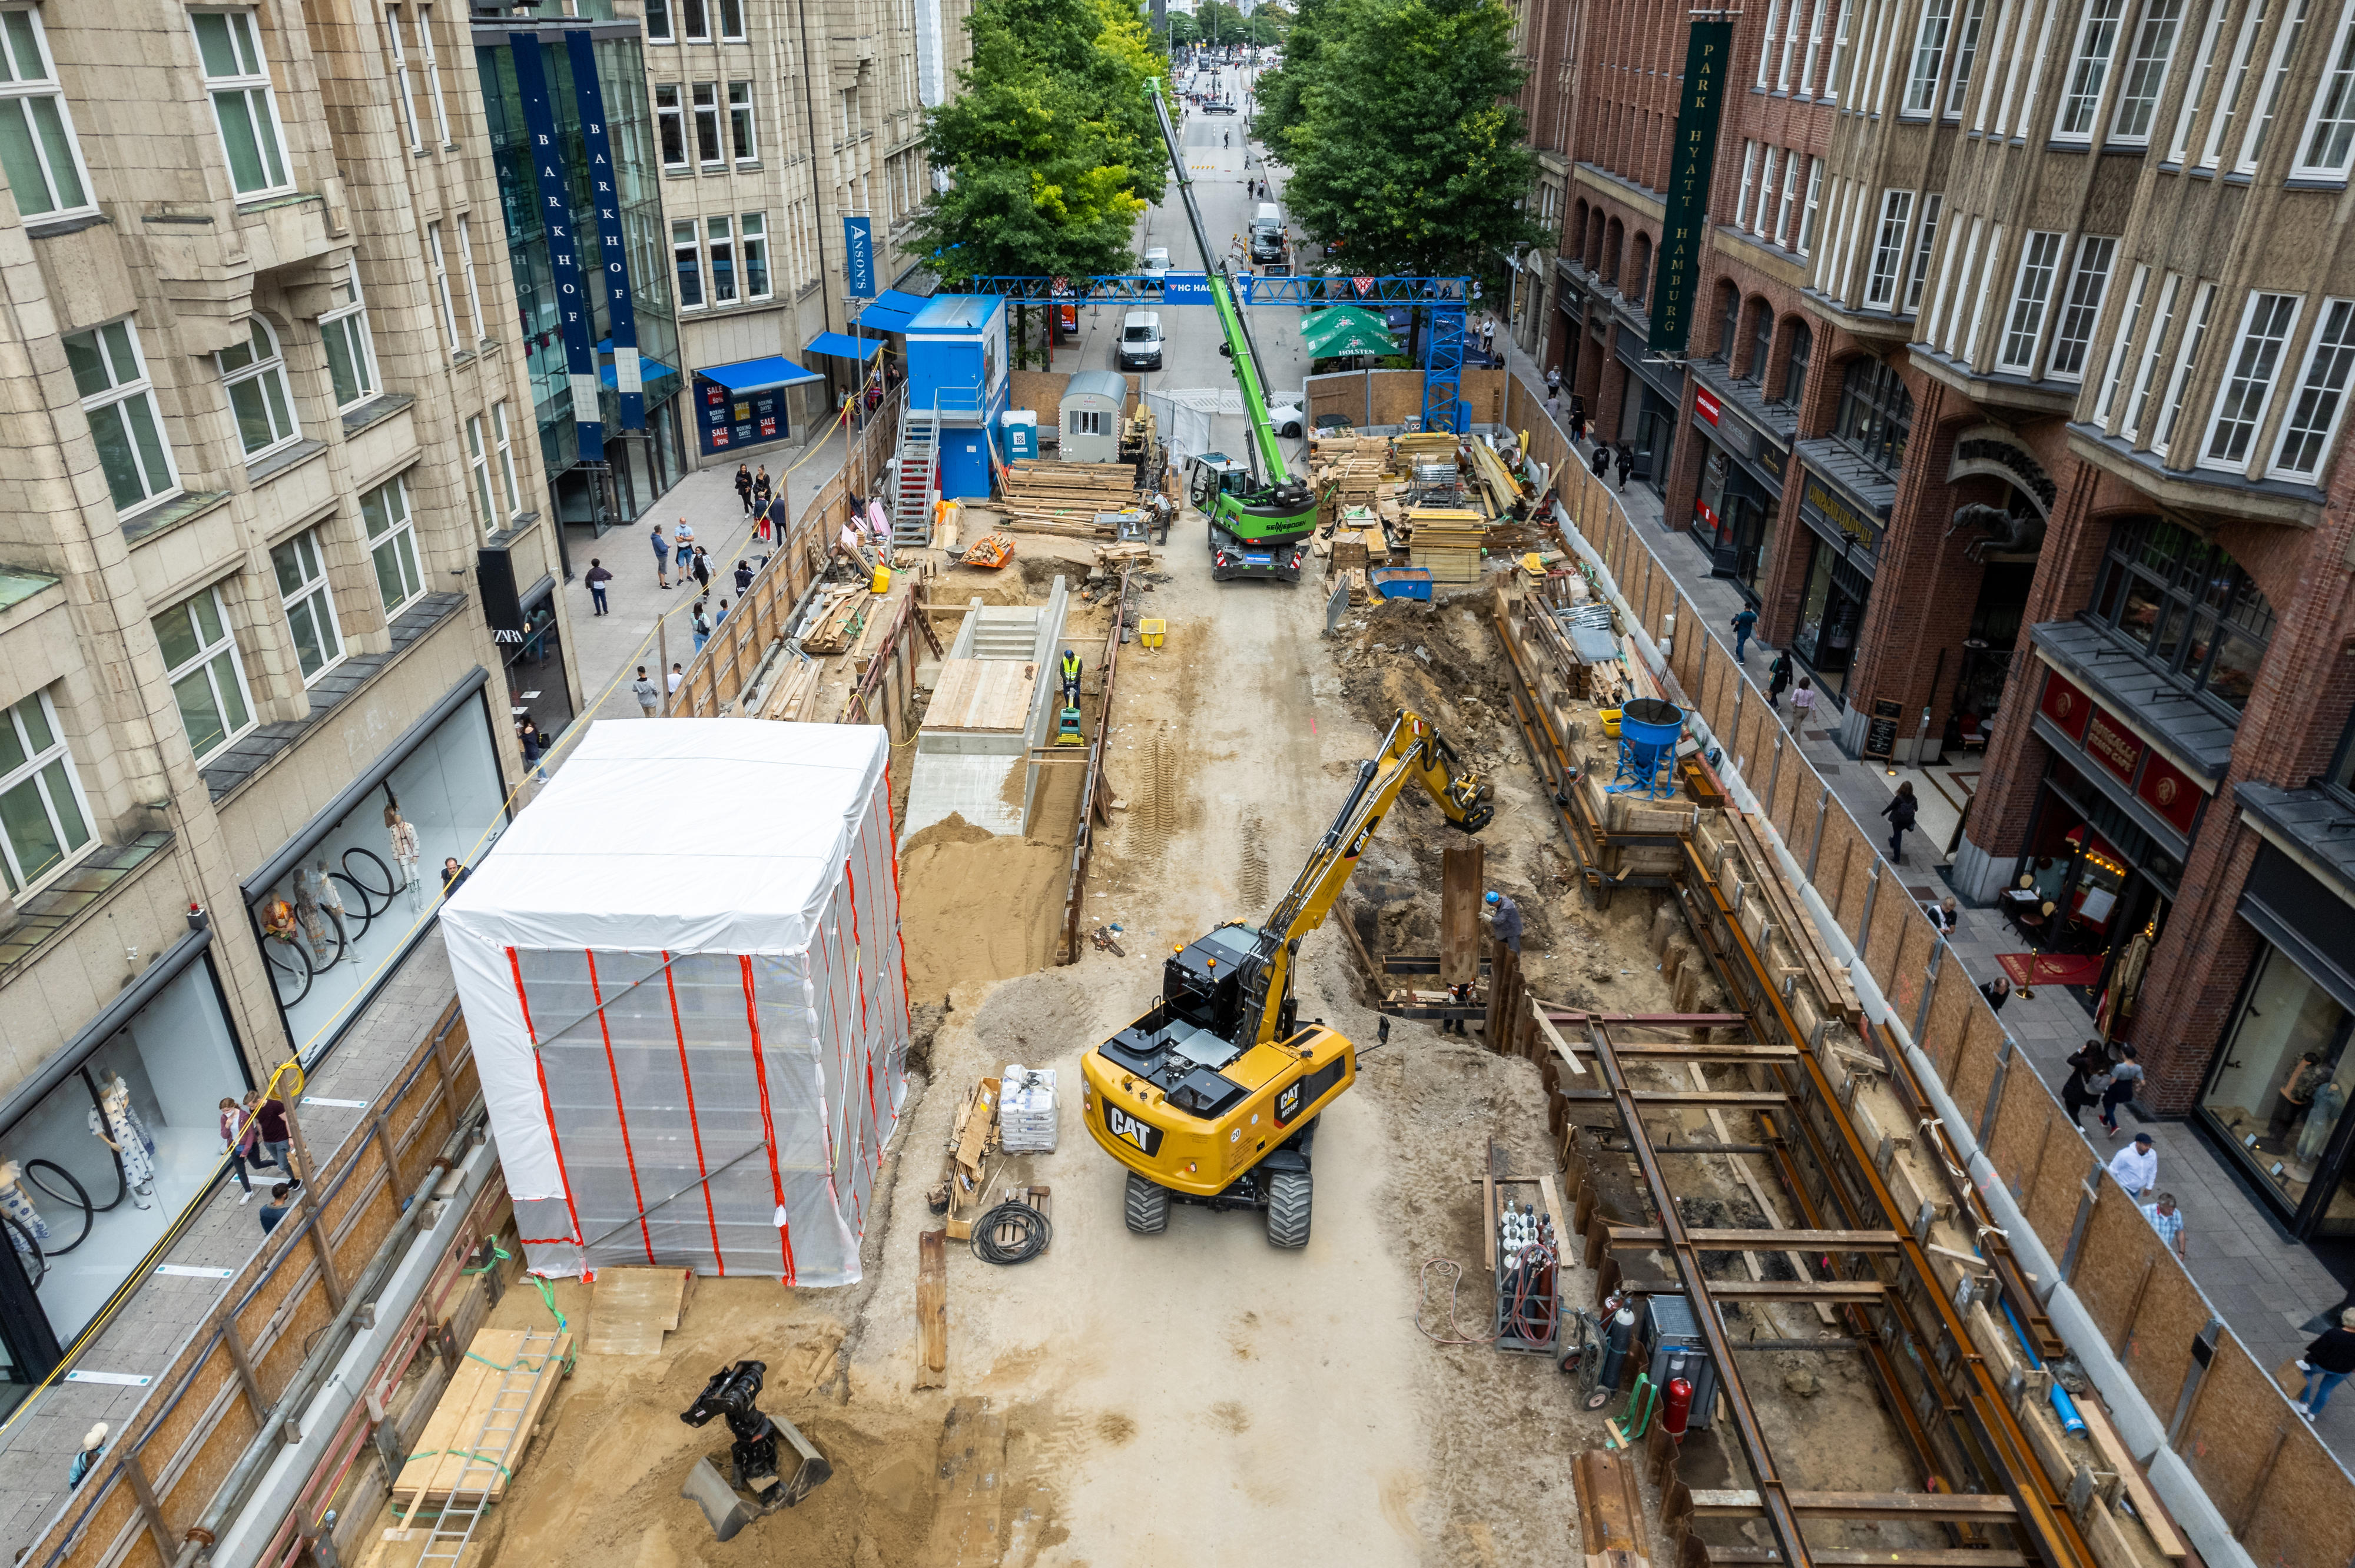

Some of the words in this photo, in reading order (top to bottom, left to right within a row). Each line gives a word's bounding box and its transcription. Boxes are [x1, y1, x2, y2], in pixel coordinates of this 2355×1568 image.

[1695, 45, 1714, 108] PARK
[1682, 131, 1701, 206] HYATT
[591, 124, 623, 298] BARKHOF
[538, 134, 578, 322] BARKHOF
[1664, 228, 1688, 331] HAMBURG
[707, 386, 723, 395] SALE
[734, 401, 749, 411] SALE
[712, 427, 728, 437] SALE
[760, 417, 775, 427] SALE
[1809, 484, 1840, 521] COMPAGNIE
[1266, 520, 1306, 533] SENNEBOGEN
[493, 630, 523, 642] ZARA
[1354, 826, 1369, 852] CAT
[1281, 1083, 1299, 1109] CAT
[1112, 1108, 1150, 1151] CAT
[1232, 1130, 1239, 1140] 20
